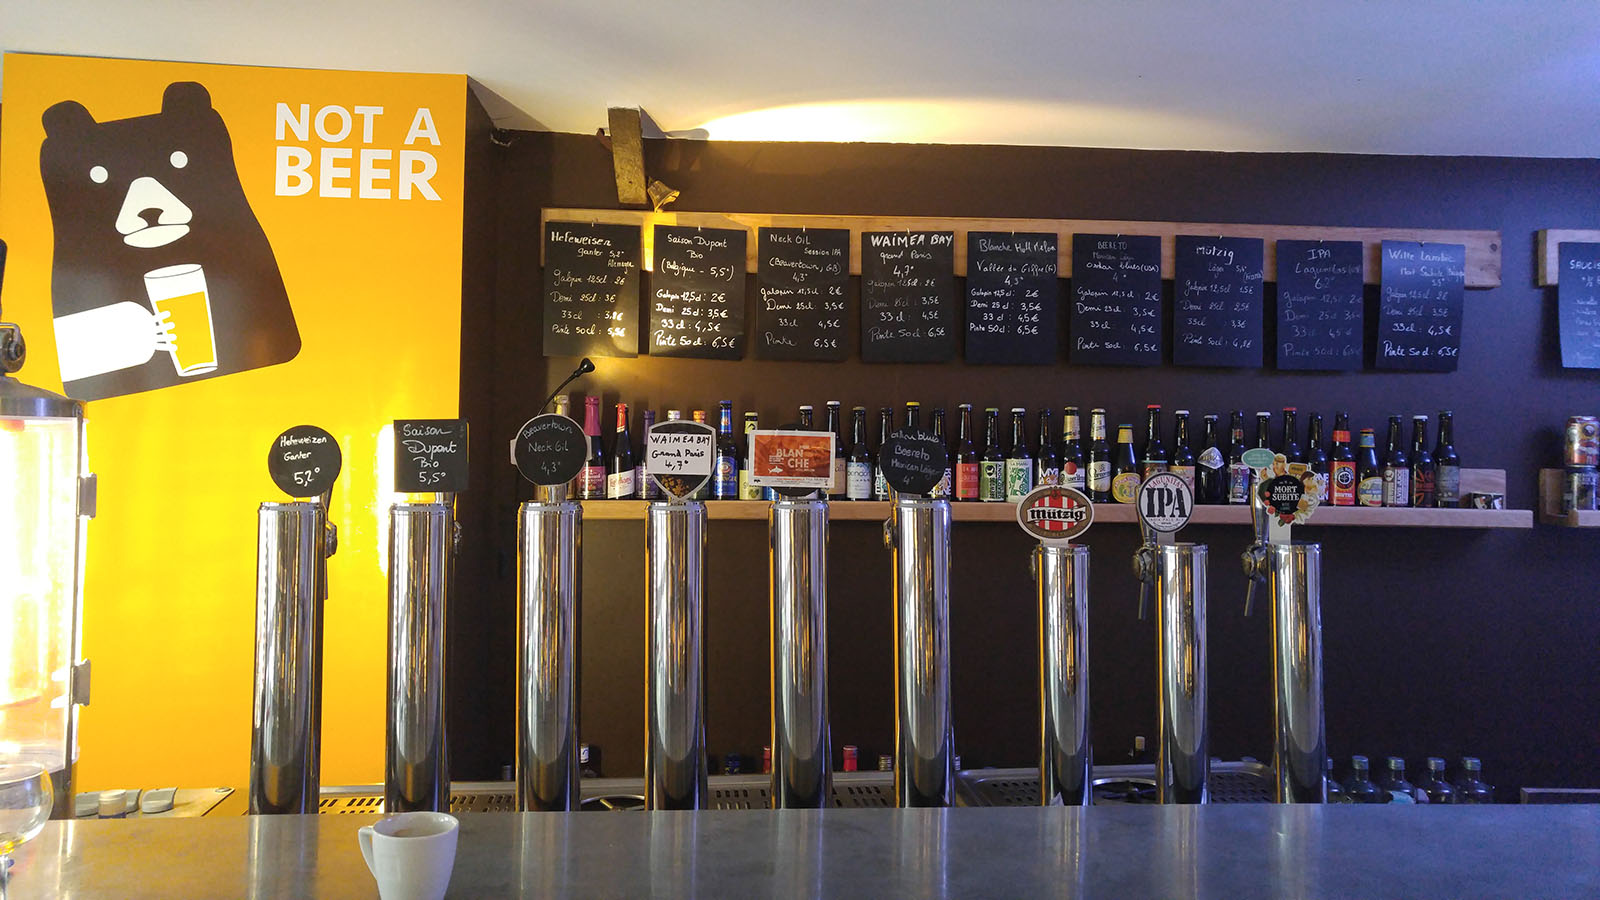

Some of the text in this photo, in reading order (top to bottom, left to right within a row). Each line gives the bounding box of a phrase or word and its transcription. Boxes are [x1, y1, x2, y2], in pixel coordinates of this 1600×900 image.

[275, 103, 441, 145] NOT A
[275, 146, 441, 200] BEER
[668, 234, 727, 251] Saison Dupont
[770, 234, 792, 243] Neck
[930, 234, 953, 247] BAY
[804, 247, 829, 255] Session
[980, 239, 1012, 252] Blanche
[687, 249, 703, 258] Bio
[911, 250, 932, 259] Paris
[1307, 249, 1330, 260] IPA
[893, 265, 914, 278] 4,7°
[829, 286, 842, 295] 2€
[605, 294, 616, 302] 3€
[711, 293, 726, 302] 2€
[922, 296, 939, 305] 3,5€
[1145, 293, 1159, 301] 2€
[767, 299, 792, 310] Demi
[825, 302, 844, 311] 3,5€
[970, 300, 1041, 311] Demi 3,5€
[1076, 303, 1101, 314] Demi
[1133, 307, 1156, 317] 3,5€
[656, 303, 728, 319] Demi 3,5€
[922, 311, 939, 320] 4,5€
[1018, 314, 1039, 322] 4,5€
[695, 321, 721, 332] 4,5€
[818, 320, 840, 329] 4,5€
[970, 323, 1039, 335] Pinte 6,5€
[1131, 324, 1155, 334] 4,5€
[868, 326, 895, 342] Pinte
[928, 328, 945, 337] 6,5€
[1428, 325, 1452, 336] 4,5€
[654, 330, 676, 346] Pinte
[712, 337, 735, 348] 6,5€
[765, 332, 837, 348] Pinte 6,5€
[1134, 343, 1157, 352] 6,5€
[1384, 340, 1458, 357] Pinte 6,5€
[403, 424, 452, 436] Saison
[523, 419, 573, 439] Beavertown
[280, 435, 327, 447] Hefeweizen
[528, 441, 552, 452] Neck
[697, 436, 710, 446] BAY
[402, 440, 456, 460] Dupont
[652, 449, 704, 458] Grand Paris
[776, 449, 803, 457] BLAN
[284, 451, 311, 461] Ganter
[413, 457, 439, 467] Bio
[665, 460, 688, 471] 4,7°
[788, 459, 809, 468] CHE
[541, 462, 560, 475] 4,3°
[294, 467, 320, 487] 5,2°
[419, 472, 446, 484] 5,5°
[1148, 477, 1184, 488] LAGUNITAS
[1146, 488, 1187, 517] IPA
